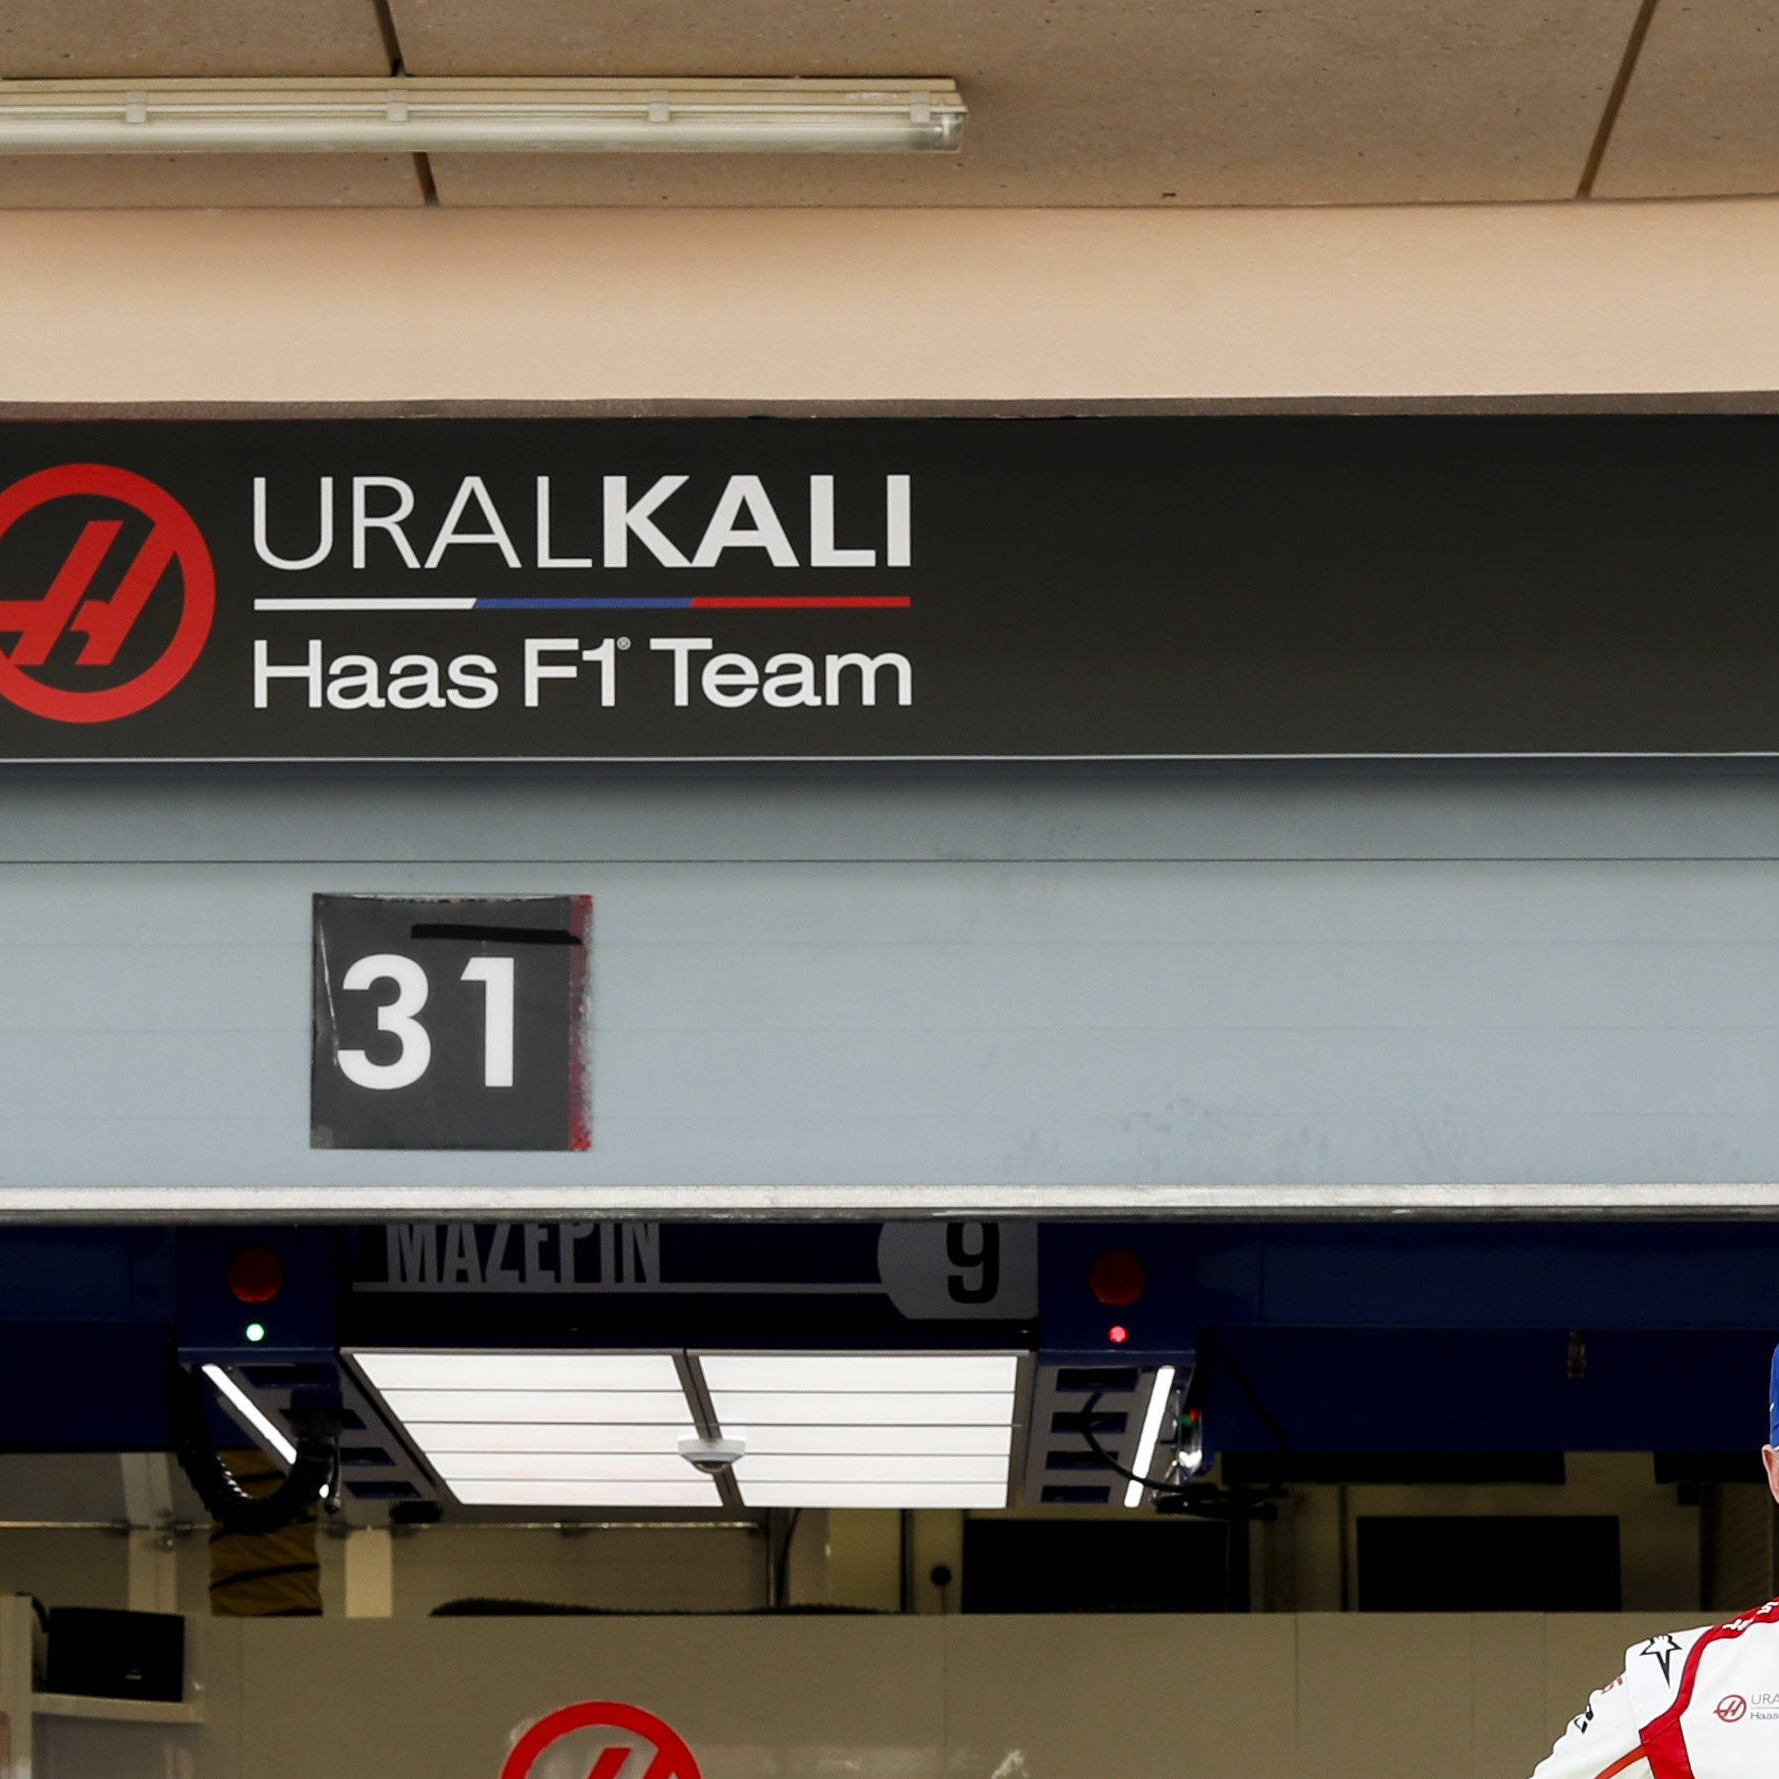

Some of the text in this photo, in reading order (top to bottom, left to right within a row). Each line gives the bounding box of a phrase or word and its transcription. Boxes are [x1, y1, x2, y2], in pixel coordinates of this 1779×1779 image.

[252, 475, 912, 570] URALKALI
[253, 639, 498, 710] Haas
[649, 637, 913, 709] Team
[336, 954, 516, 1091] 31
[945, 1222, 1001, 1305] 9
